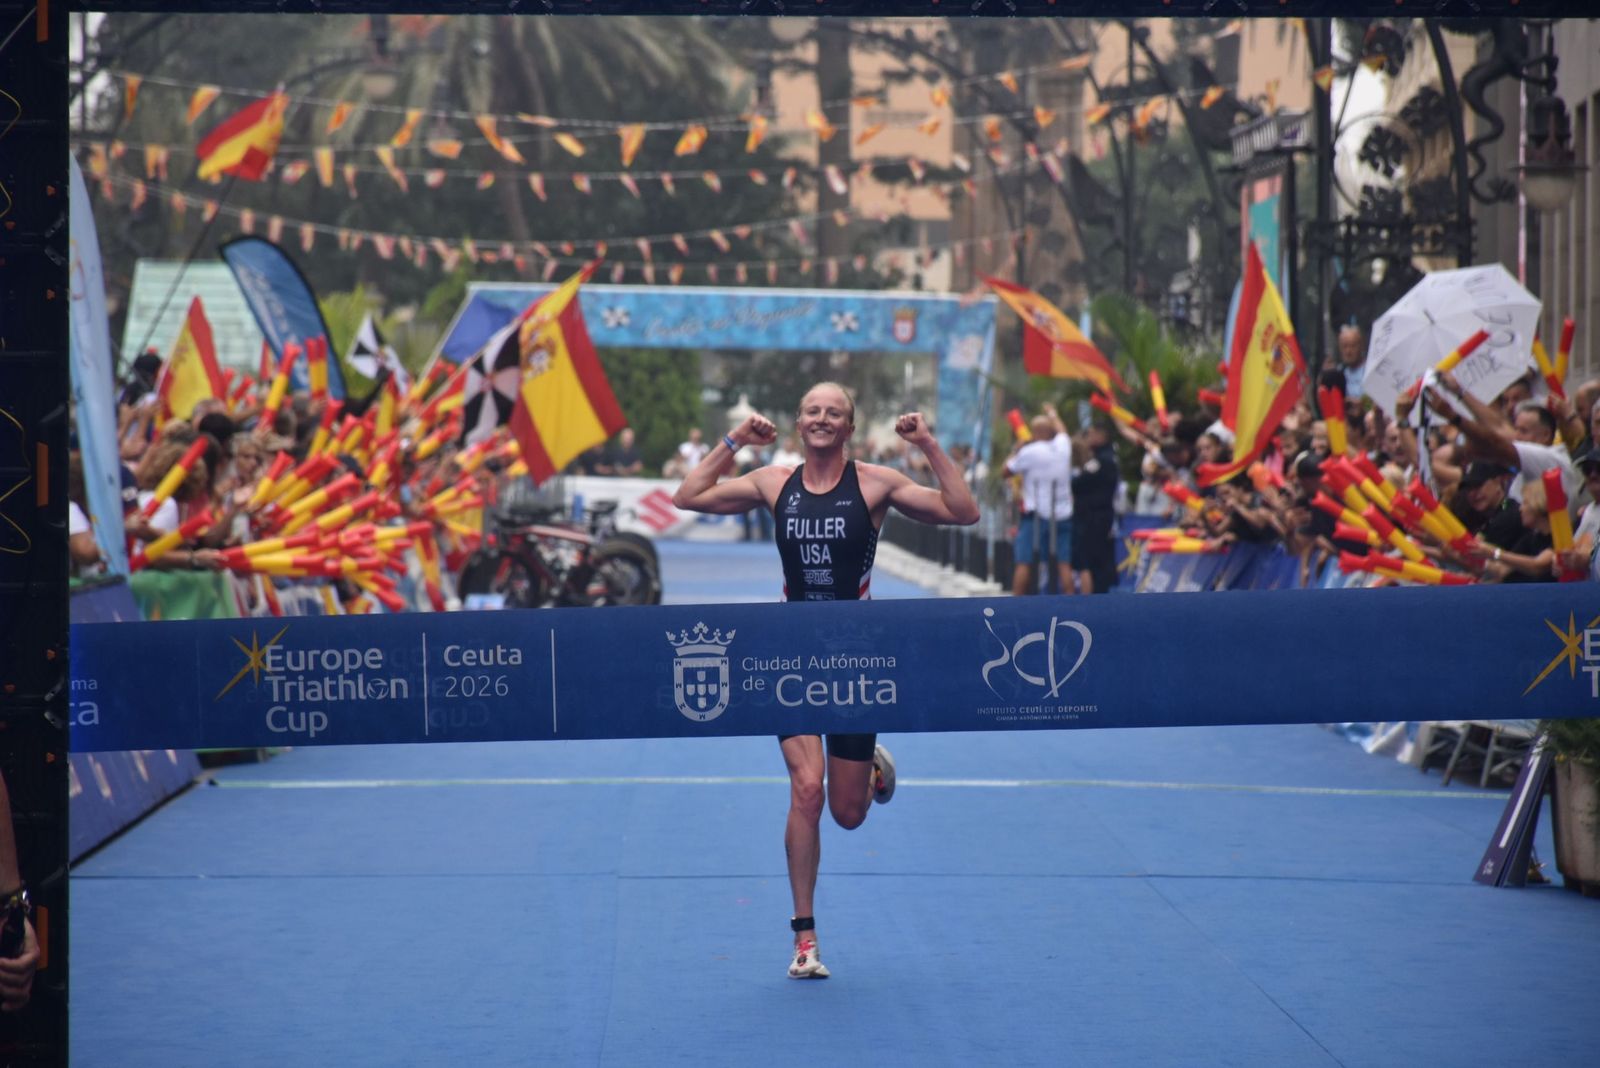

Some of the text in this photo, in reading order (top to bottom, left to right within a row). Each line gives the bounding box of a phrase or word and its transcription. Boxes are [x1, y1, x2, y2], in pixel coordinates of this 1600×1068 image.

[786, 517, 846, 539] FULLER
[800, 543, 832, 564] USA
[265, 644, 383, 673] Europe
[443, 644, 522, 667] Ceuta
[742, 653, 897, 671] Ciudad Autónoma
[264, 673, 409, 702] Triathlon
[444, 675, 509, 698] 2026
[742, 673, 898, 707] de Ceuta
[977, 706, 1016, 715] INSTITUTO
[1058, 704, 1098, 713] DEPORTES
[265, 706, 329, 738] Cup
